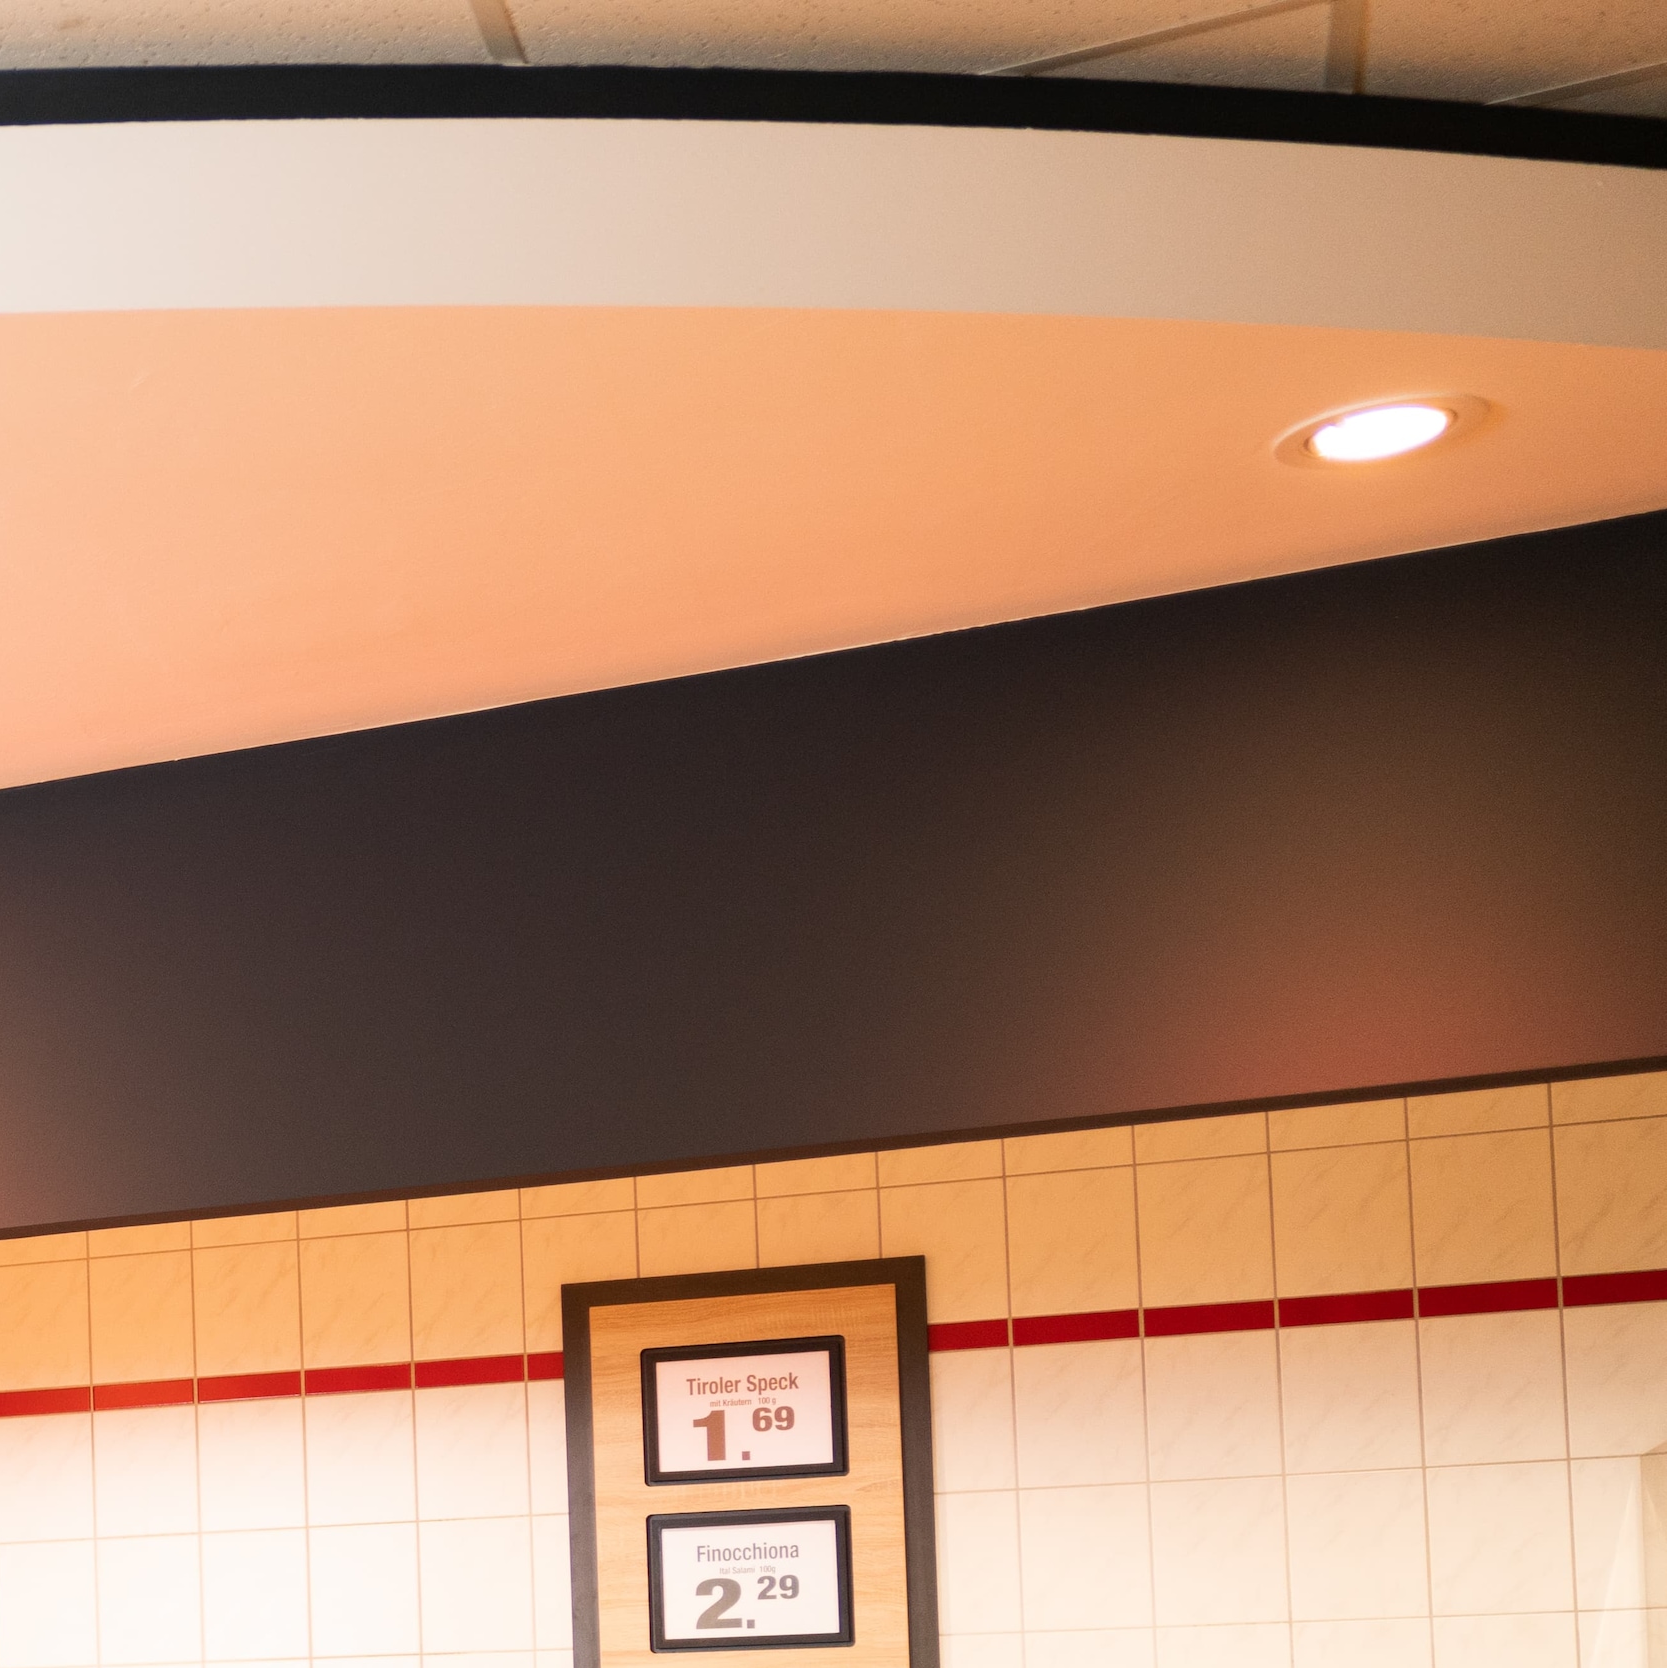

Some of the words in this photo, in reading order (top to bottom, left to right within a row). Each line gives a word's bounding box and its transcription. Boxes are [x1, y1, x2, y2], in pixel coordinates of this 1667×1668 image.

[686, 1376, 741, 1395] Tiroler
[746, 1372, 799, 1396] Speck
[722, 1398, 752, 1407] Kräutern
[696, 1542, 799, 1562] Finocchiona
[732, 1566, 755, 1574] Salami
